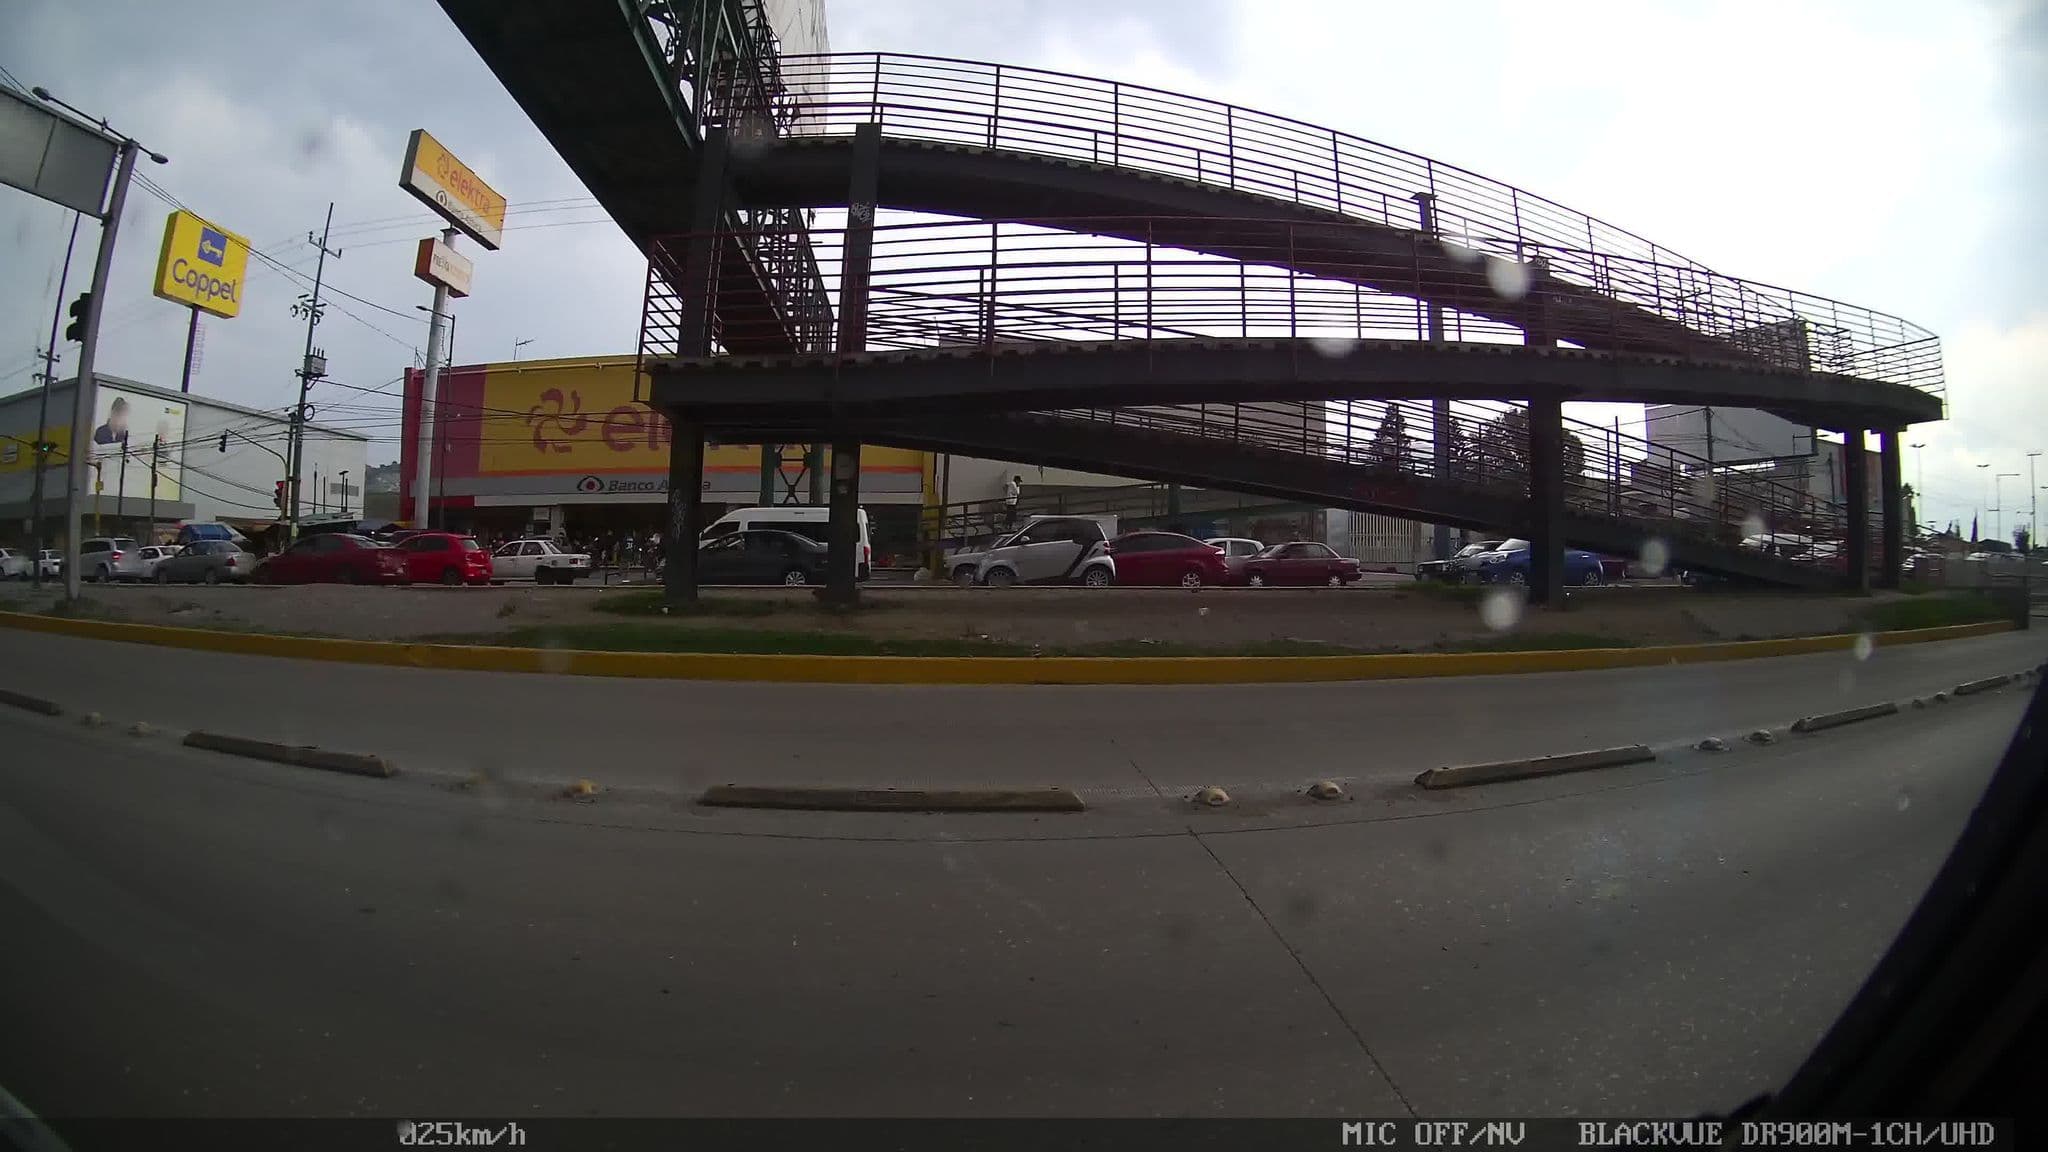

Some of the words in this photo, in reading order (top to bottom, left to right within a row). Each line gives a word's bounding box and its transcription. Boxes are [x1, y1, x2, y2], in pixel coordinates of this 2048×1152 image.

[449, 169, 490, 214] elektra
[172, 258, 237, 303] Coppel
[608, 480, 654, 491] Banco
